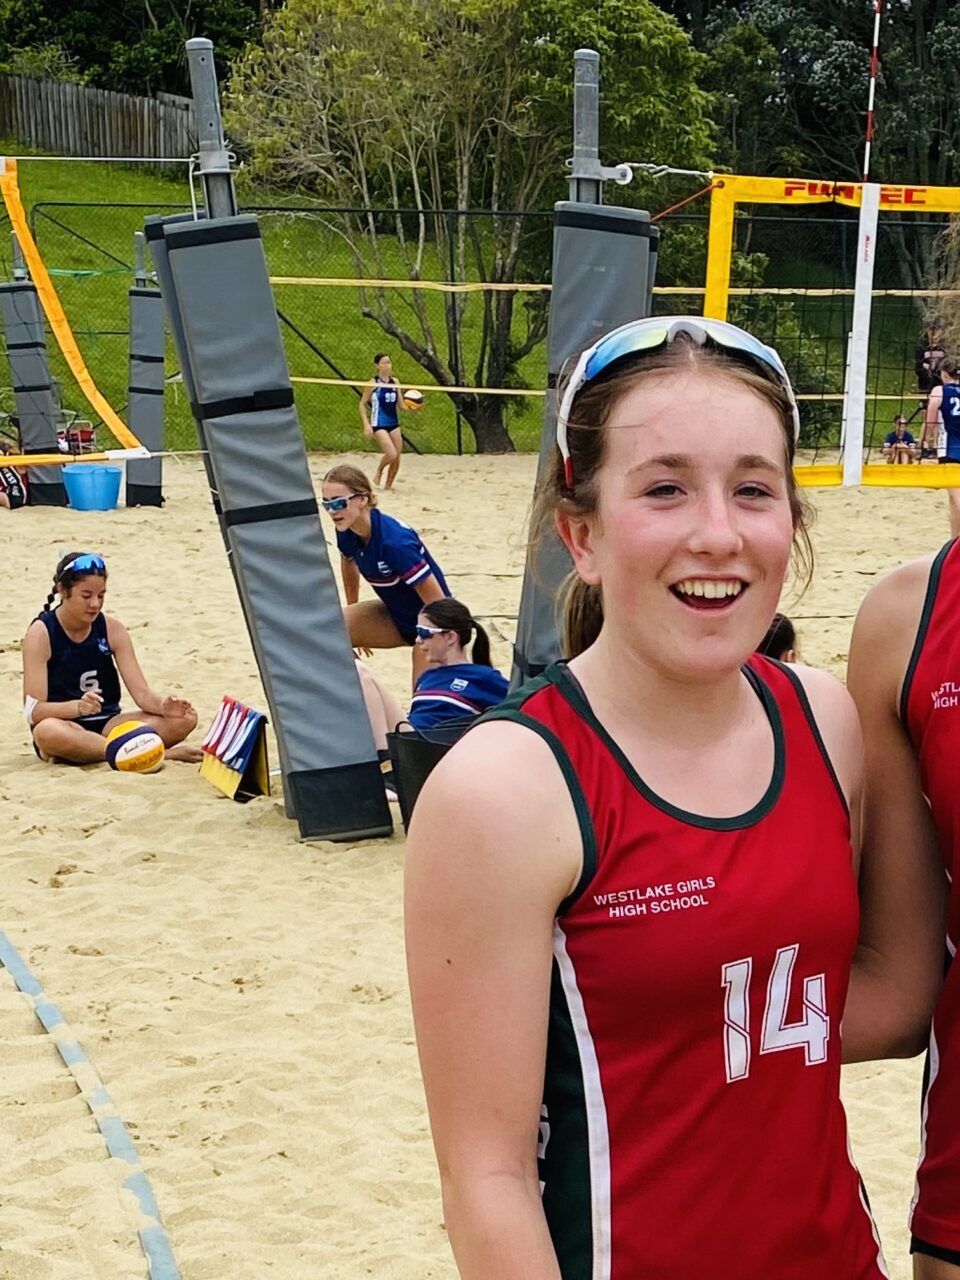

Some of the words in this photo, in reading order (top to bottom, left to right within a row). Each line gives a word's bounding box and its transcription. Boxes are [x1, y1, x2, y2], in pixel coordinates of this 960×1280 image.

[784, 181, 927, 204] FUNEC
[80, 670, 100, 692] 6
[593, 883, 674, 906] WESTLAKE
[677, 876, 716, 893] GIRLS
[609, 903, 647, 918] HIGH
[650, 894, 709, 913] SCHOOL
[721, 943, 830, 1084] 14
